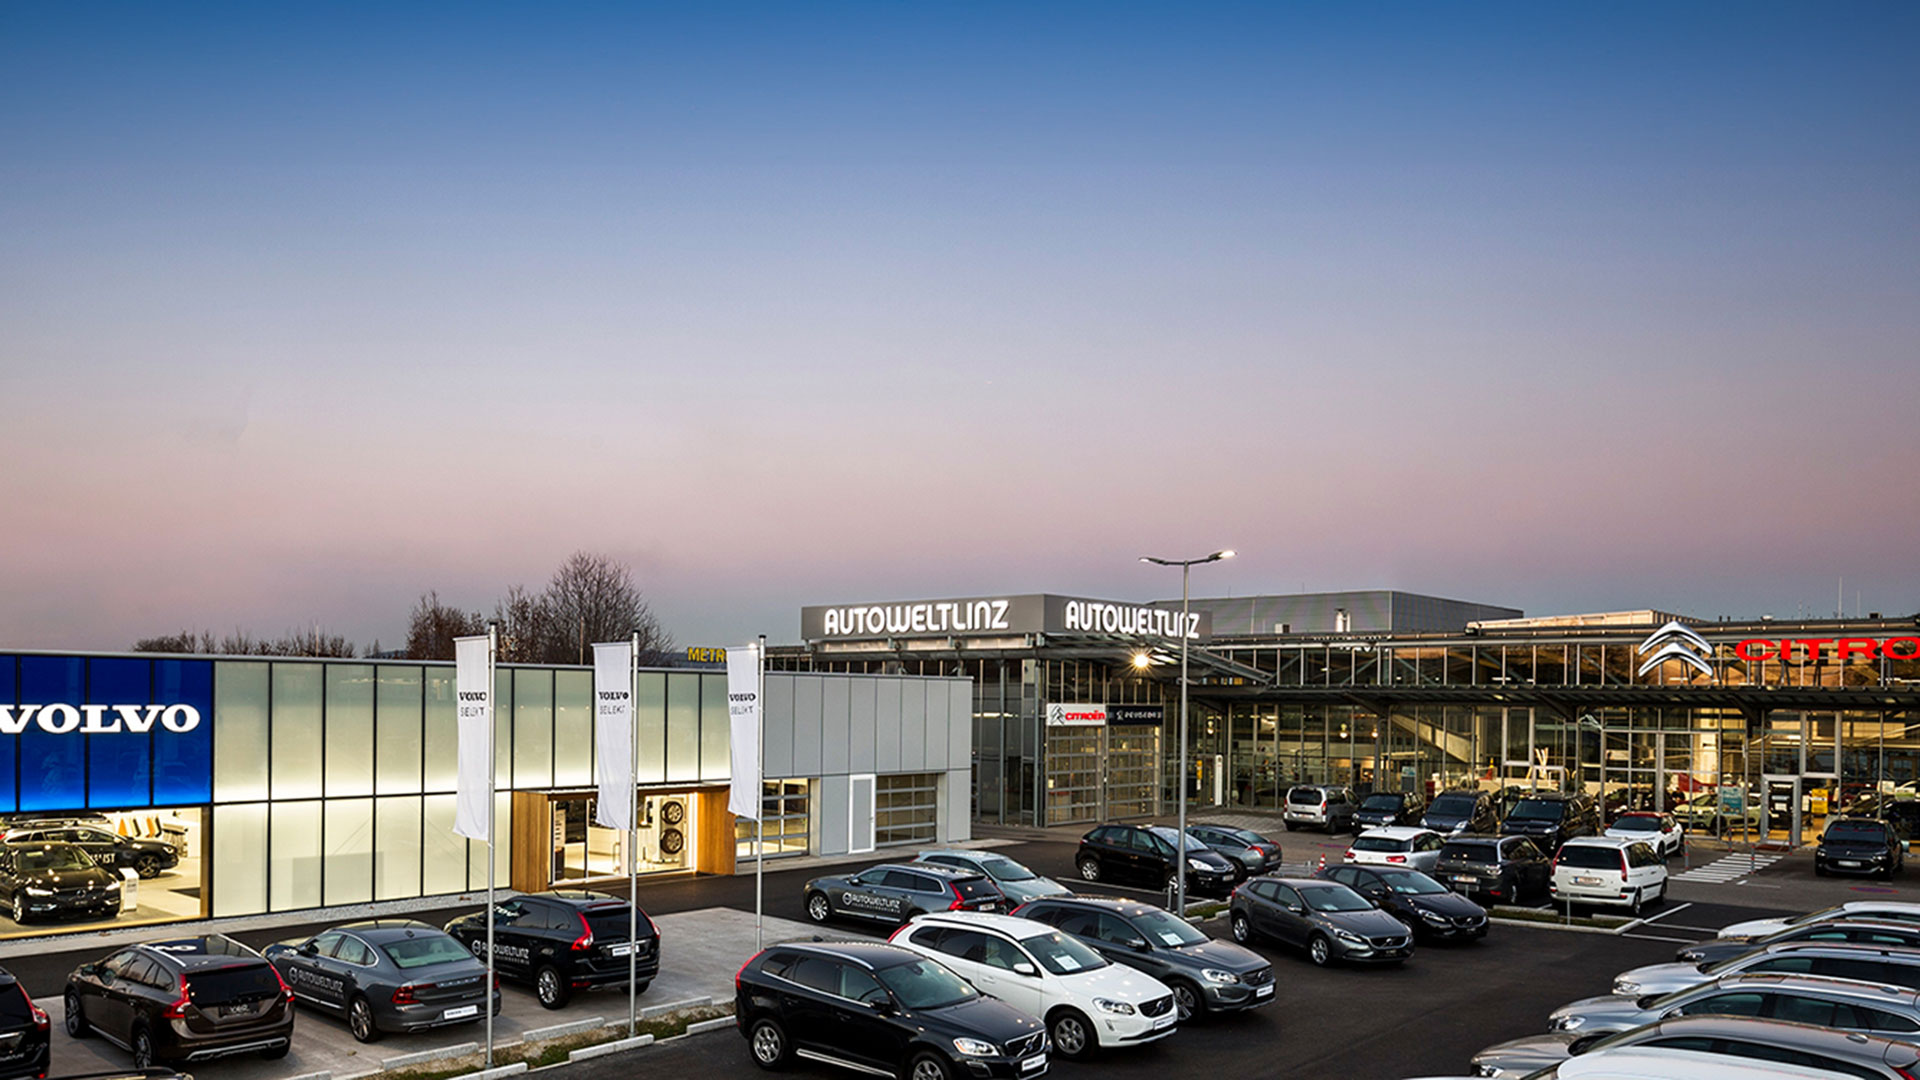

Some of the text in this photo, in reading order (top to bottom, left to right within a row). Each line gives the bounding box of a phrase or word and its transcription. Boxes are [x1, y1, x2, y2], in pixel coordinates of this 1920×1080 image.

[824, 600, 1010, 635] AUTOWELTLINZ
[1065, 600, 1200, 639] AUTOWELTLINZ
[687, 647, 727, 662] METR
[1735, 636, 1920, 661] CITRO
[598, 691, 629, 701] VOLVO
[0, 703, 201, 734] VOLVO
[460, 706, 485, 717] SELKT
[482, 941, 529, 959] AOWELTLINZ
